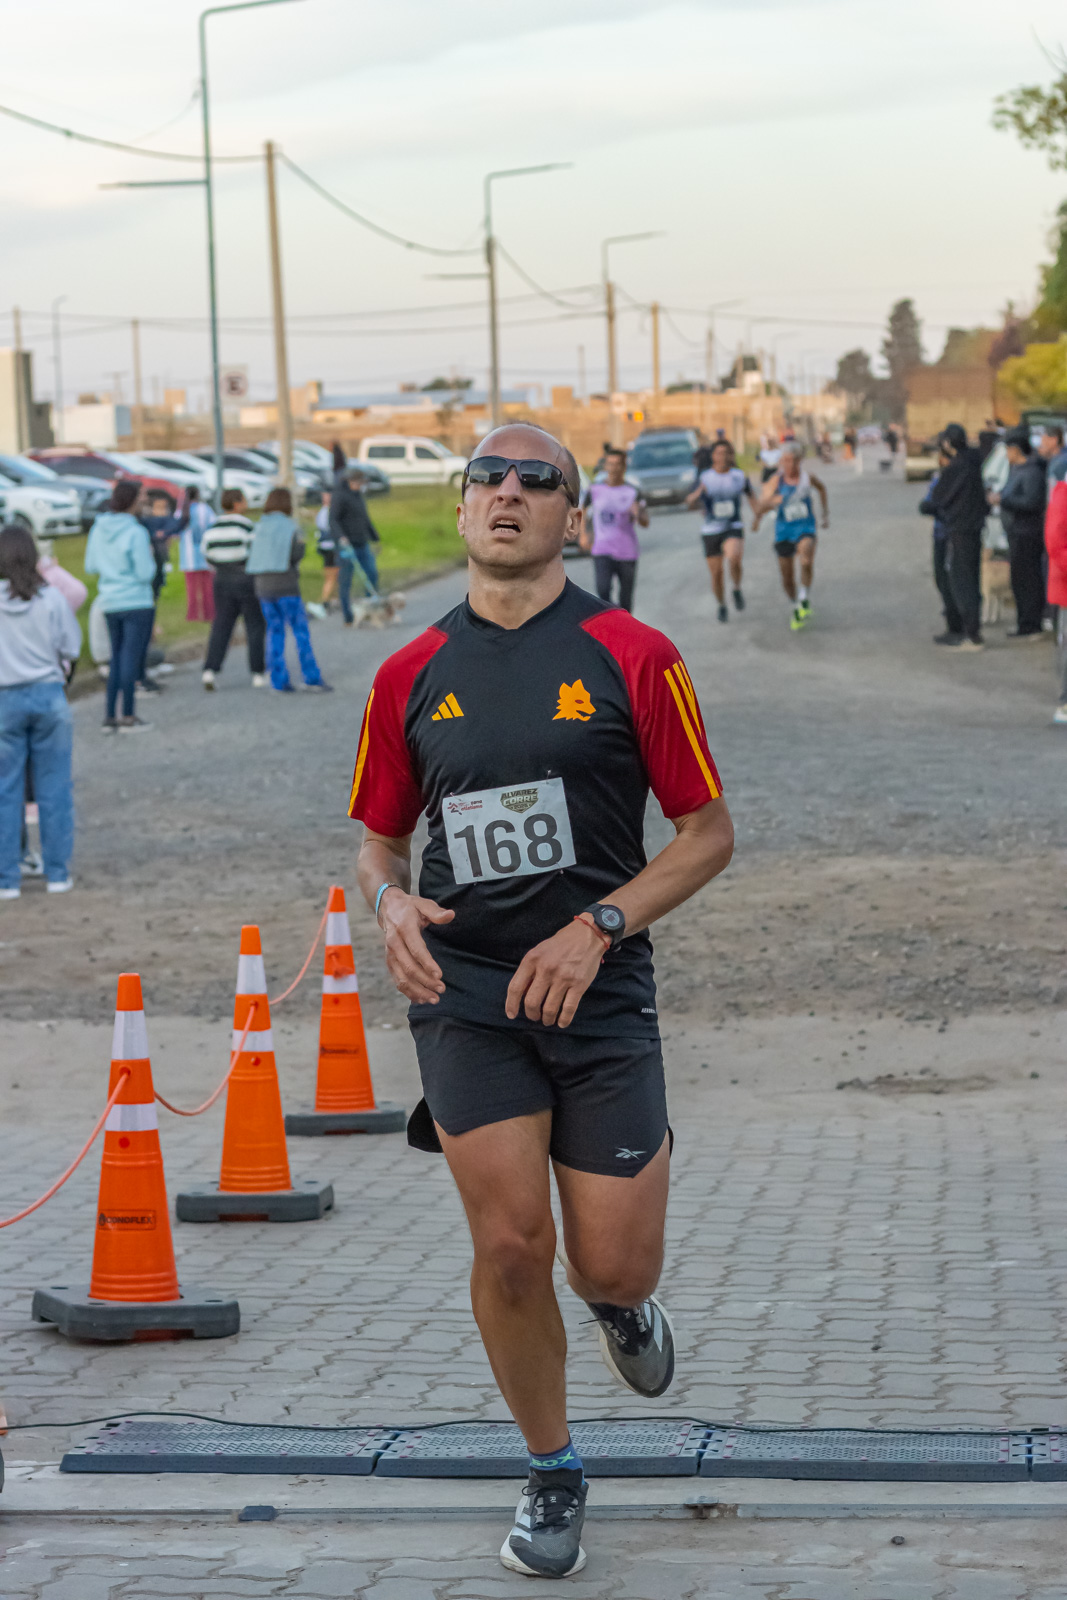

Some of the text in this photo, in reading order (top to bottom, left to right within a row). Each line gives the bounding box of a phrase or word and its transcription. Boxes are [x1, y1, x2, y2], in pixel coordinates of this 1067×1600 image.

[501, 788, 538, 799] ALVAREZ
[503, 794, 537, 806] CORRE
[454, 813, 563, 878] 168
[106, 1216, 153, 1224] CONOFLEX
